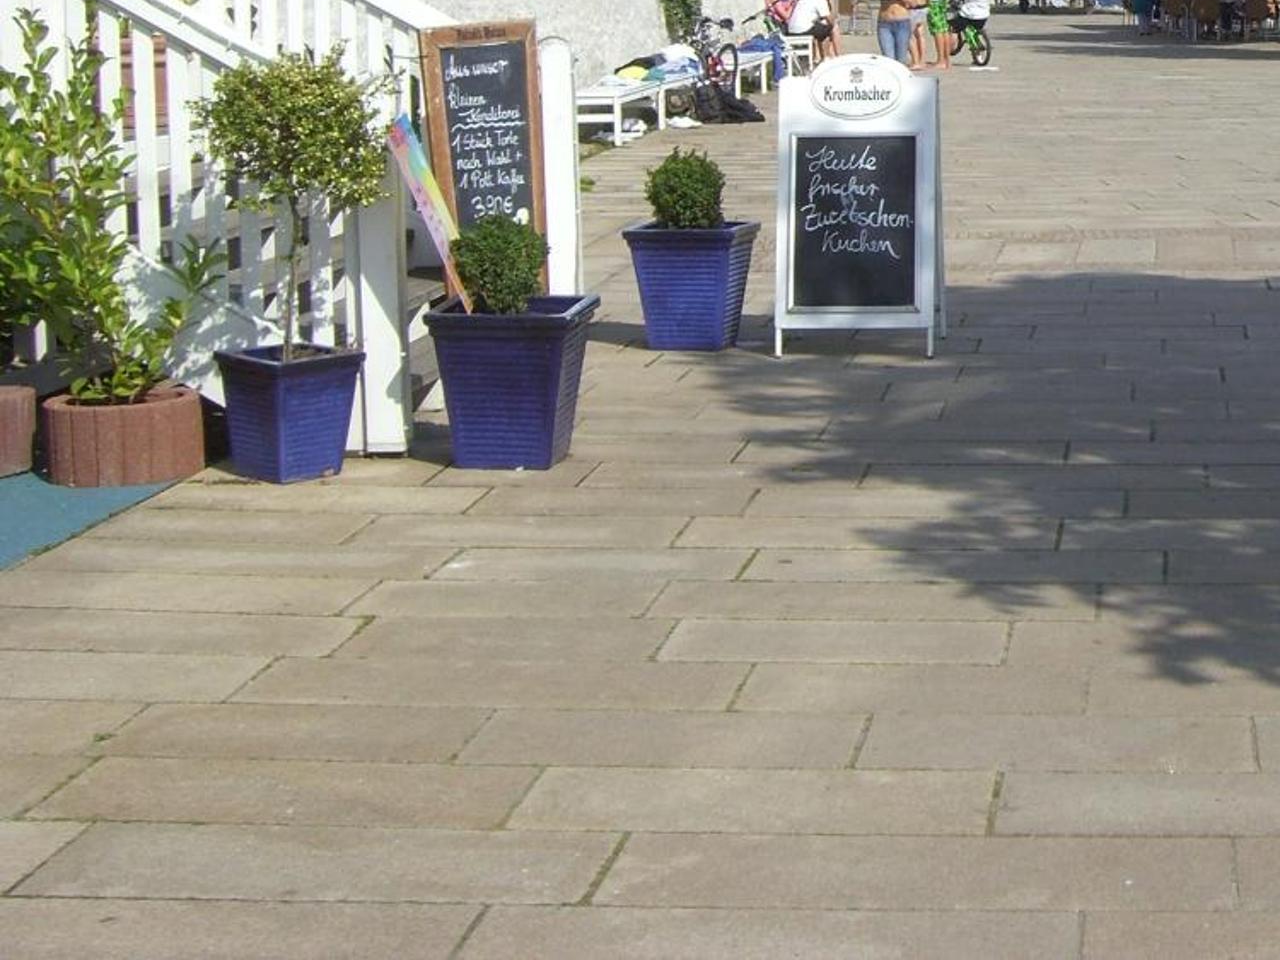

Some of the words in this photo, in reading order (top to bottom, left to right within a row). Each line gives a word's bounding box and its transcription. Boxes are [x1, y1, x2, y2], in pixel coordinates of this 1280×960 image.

[823, 85, 891, 102] Krombacher
[452, 134, 461, 154] 1
[463, 131, 493, 150] Stück
[494, 129, 520, 146] Torte
[456, 152, 482, 170] nach
[486, 148, 512, 166] Wahl
[805, 145, 878, 172] Heute
[470, 169, 495, 188] Pott
[497, 168, 526, 194] Kaffee
